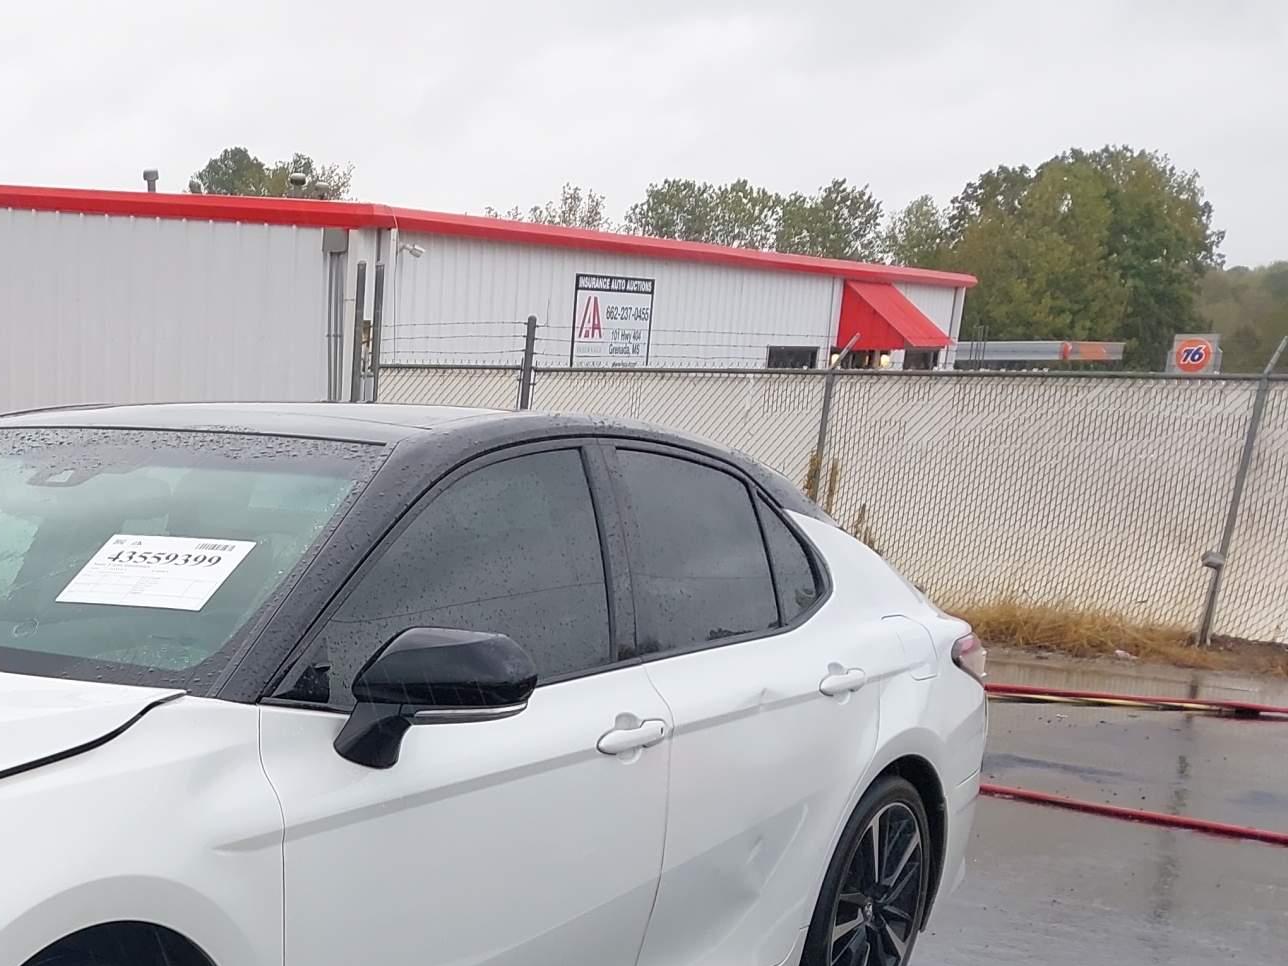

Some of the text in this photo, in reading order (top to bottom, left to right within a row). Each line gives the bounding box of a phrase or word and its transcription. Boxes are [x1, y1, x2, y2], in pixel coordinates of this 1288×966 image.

[578, 275, 652, 293] INSURANCE AUTO AUCTIONS
[606, 305, 649, 321] 662-237-0455
[621, 329, 632, 344] Hwy
[632, 342, 640, 355] MS
[1180, 344, 1207, 364] 76
[107, 550, 222, 568] 43559399
